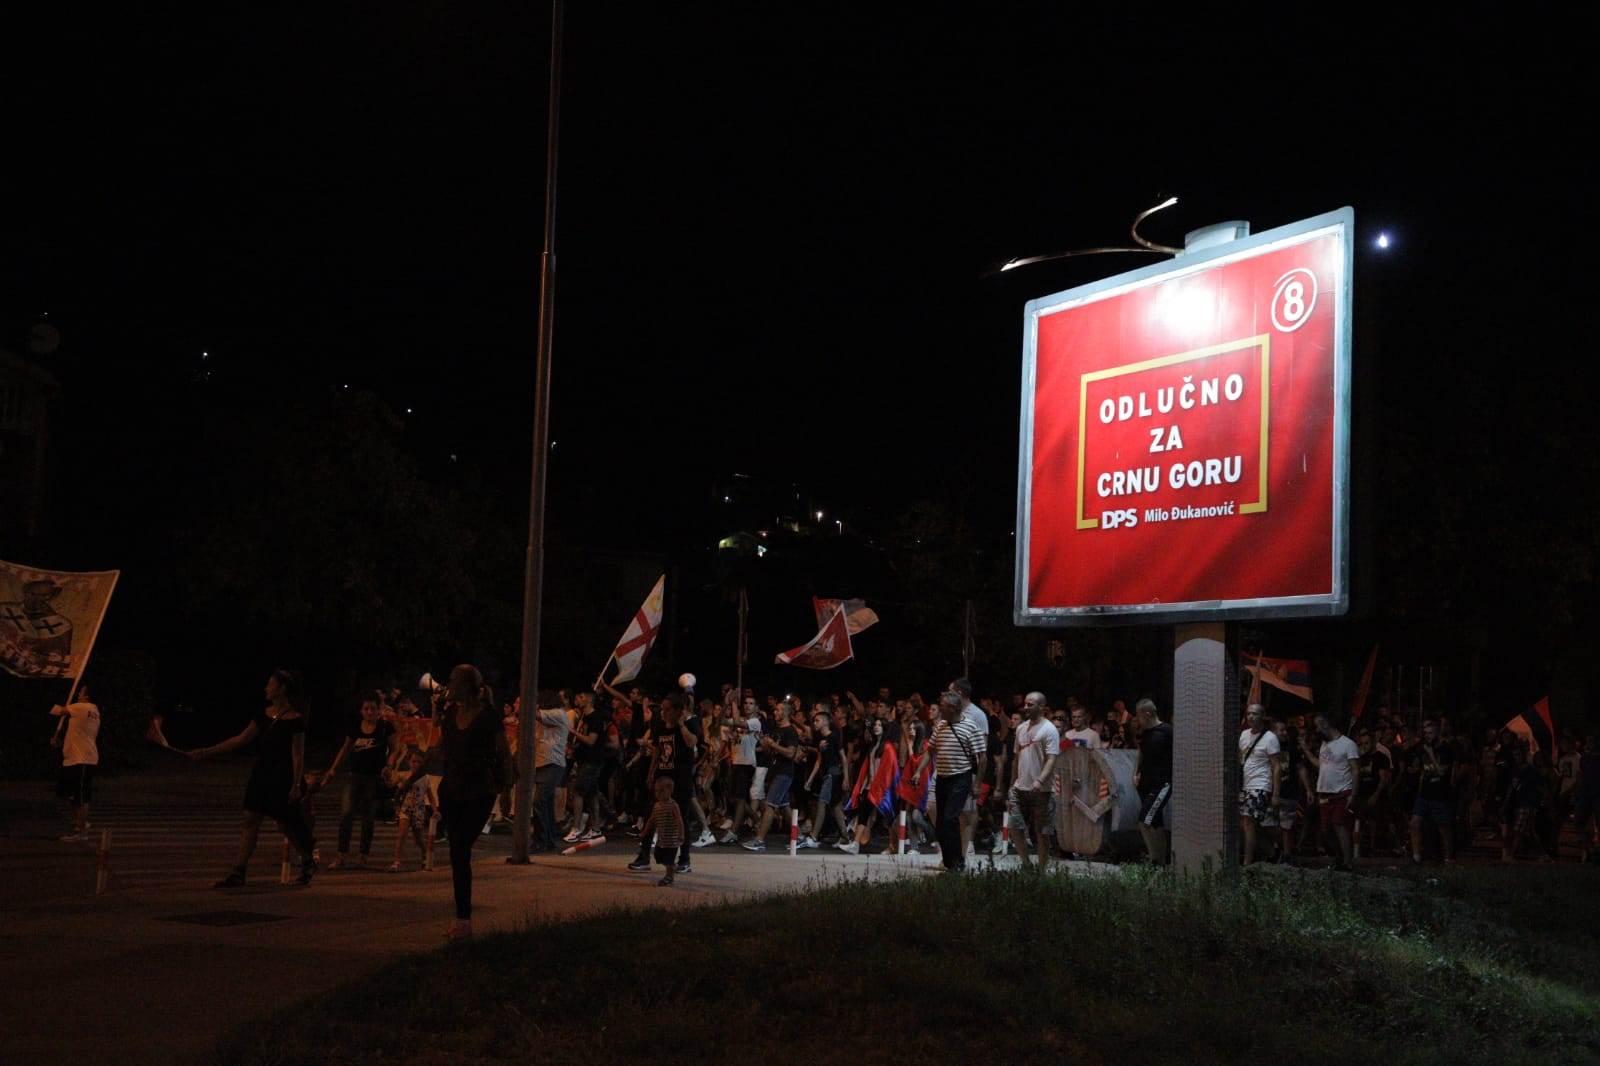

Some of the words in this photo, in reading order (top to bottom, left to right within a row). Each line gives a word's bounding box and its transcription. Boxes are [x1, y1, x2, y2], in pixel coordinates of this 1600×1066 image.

[1283, 282, 1304, 321] 8
[1099, 374, 1244, 424] ODLUČNO
[1149, 425, 1184, 454] ZA
[1096, 467, 1161, 498] CRNU
[1168, 456, 1243, 490] GORU
[1101, 508, 1138, 529] DPS
[1144, 507, 1169, 523] Milo
[1170, 502, 1235, 521] Đukanović
